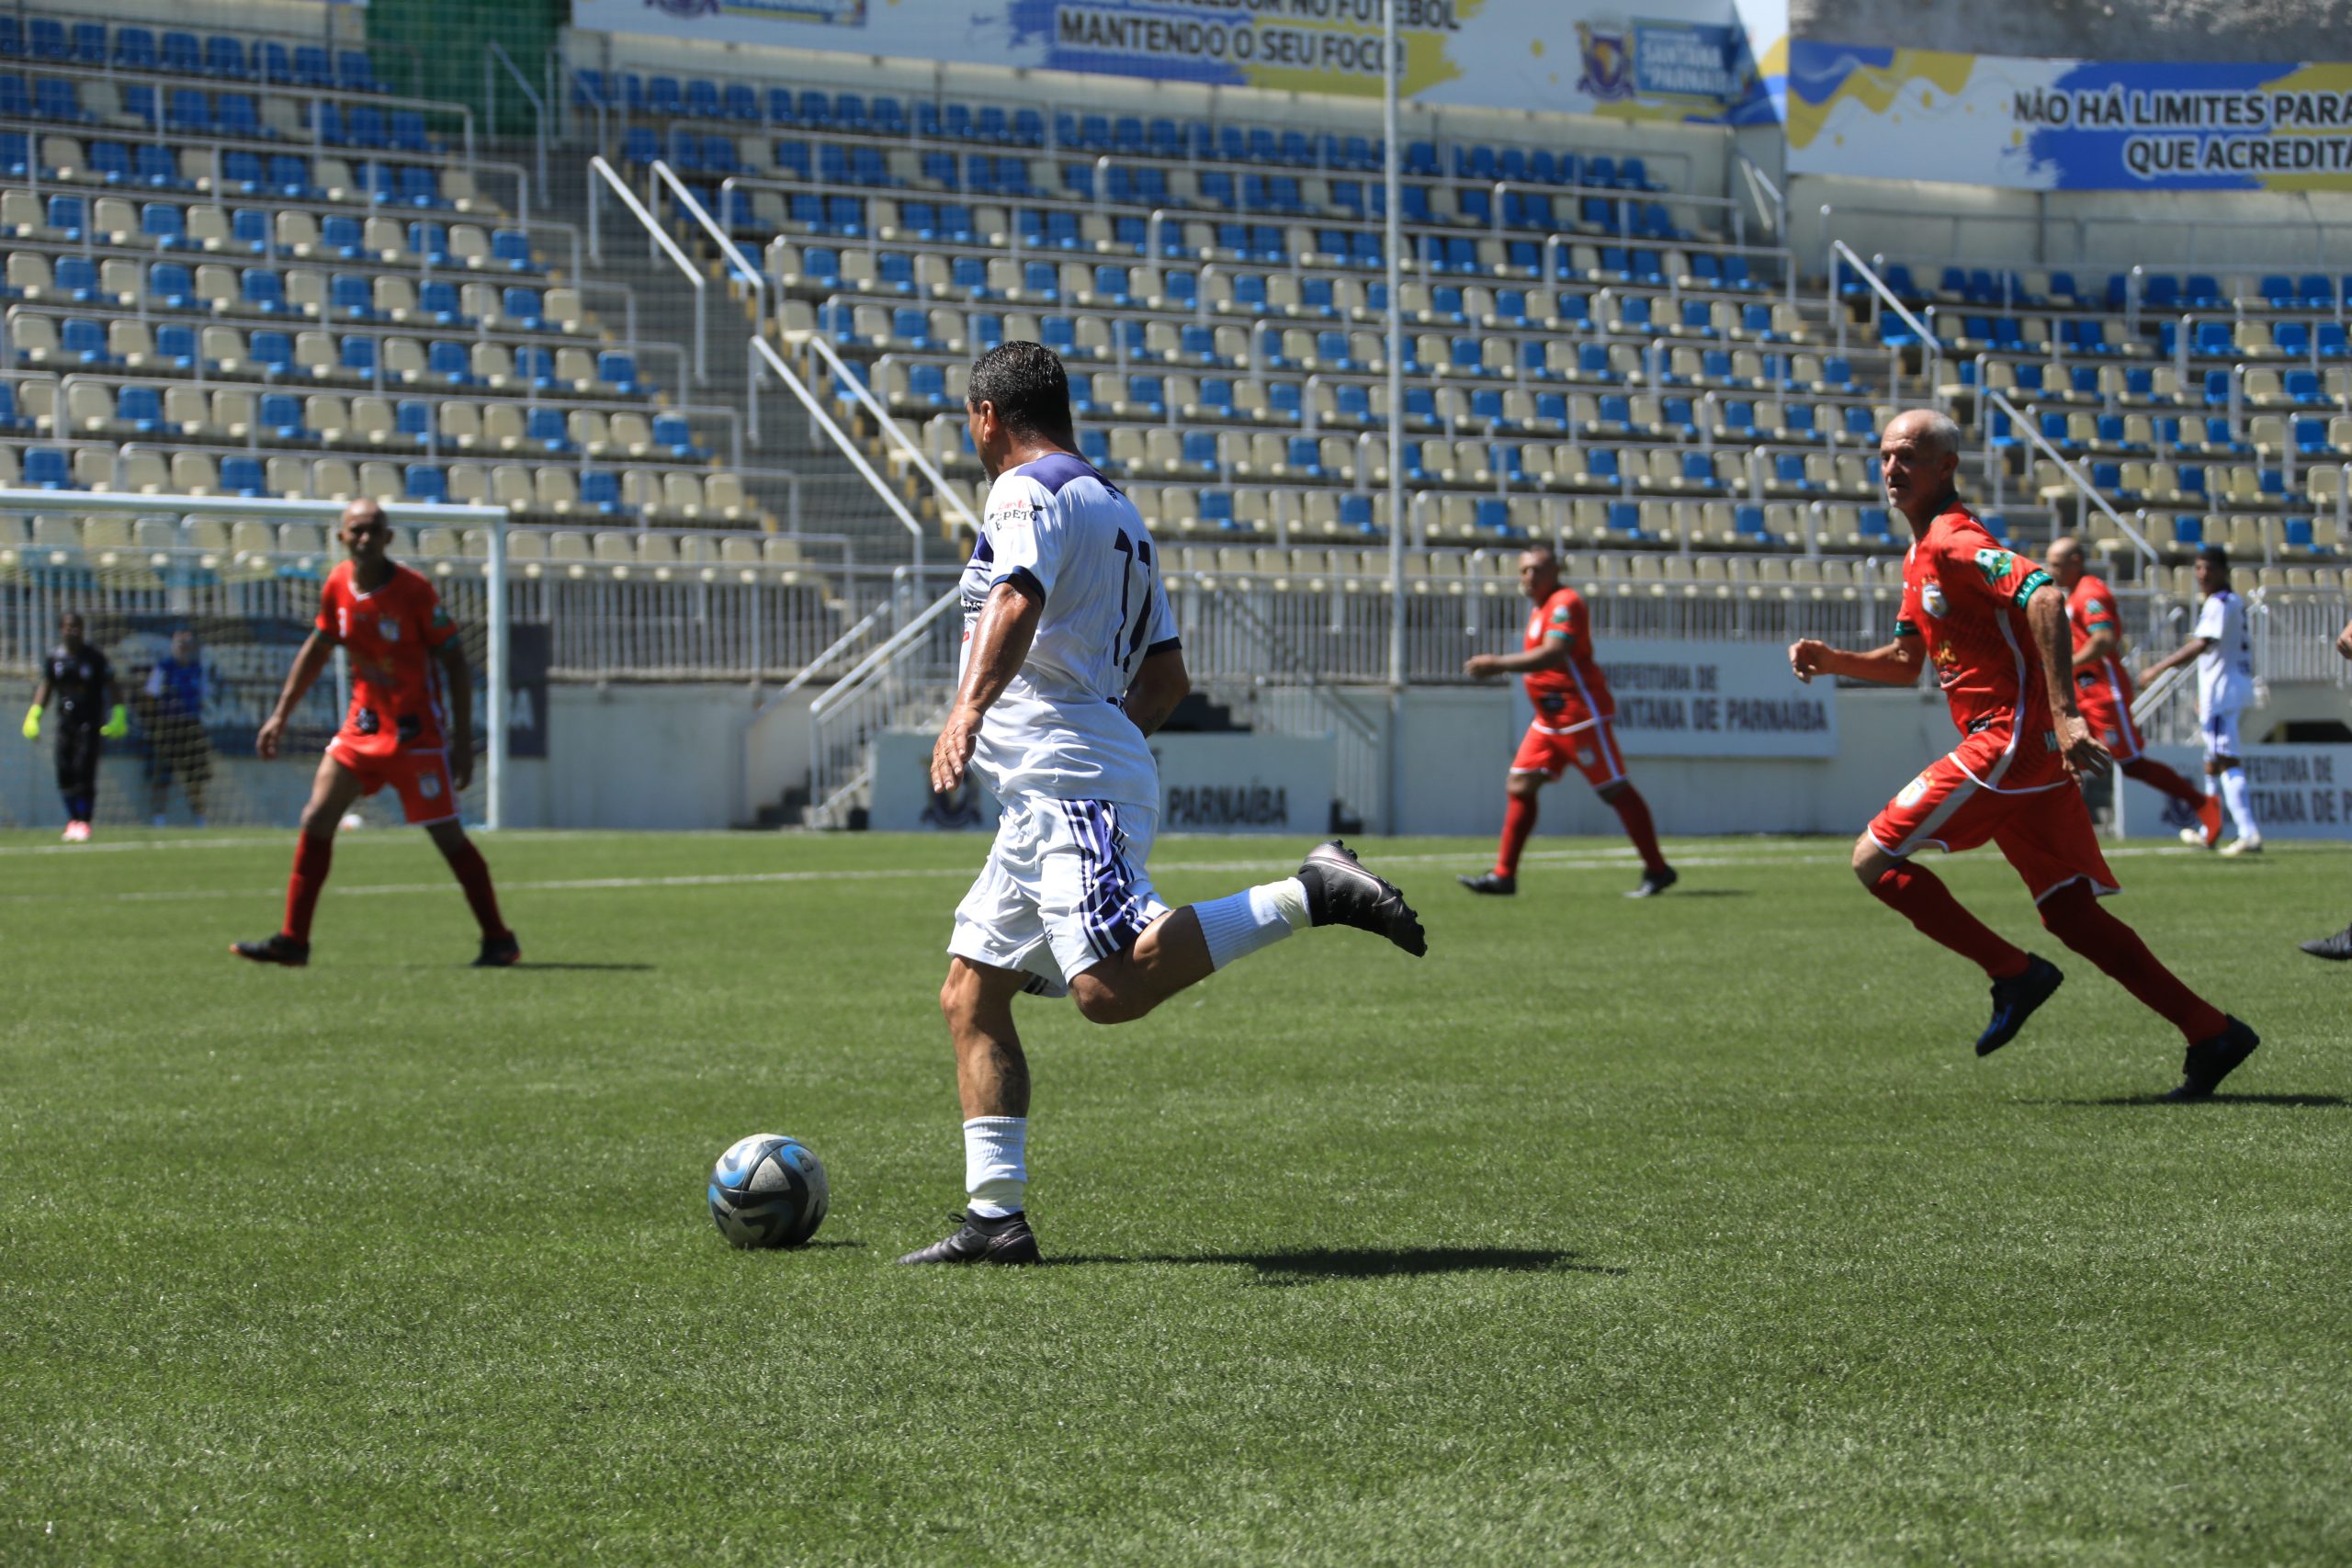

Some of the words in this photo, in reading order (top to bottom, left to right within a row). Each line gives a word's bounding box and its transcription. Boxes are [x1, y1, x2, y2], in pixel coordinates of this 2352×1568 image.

[1061, 10, 1226, 57] MANTENDO
[1234, 28, 1253, 59] O
[1262, 29, 1314, 64] SEU
[2015, 86, 2067, 124] NÃO
[2080, 86, 2124, 124] HÁ
[2135, 96, 2265, 124] LIMITES
[2128, 141, 2195, 173] QUE
[1602, 663, 1691, 689] REFEITURA
[1697, 664, 1718, 691] DE
[1614, 698, 1688, 728] NTANA
[1693, 698, 1720, 730] DE
[2312, 790, 2336, 822] DE
